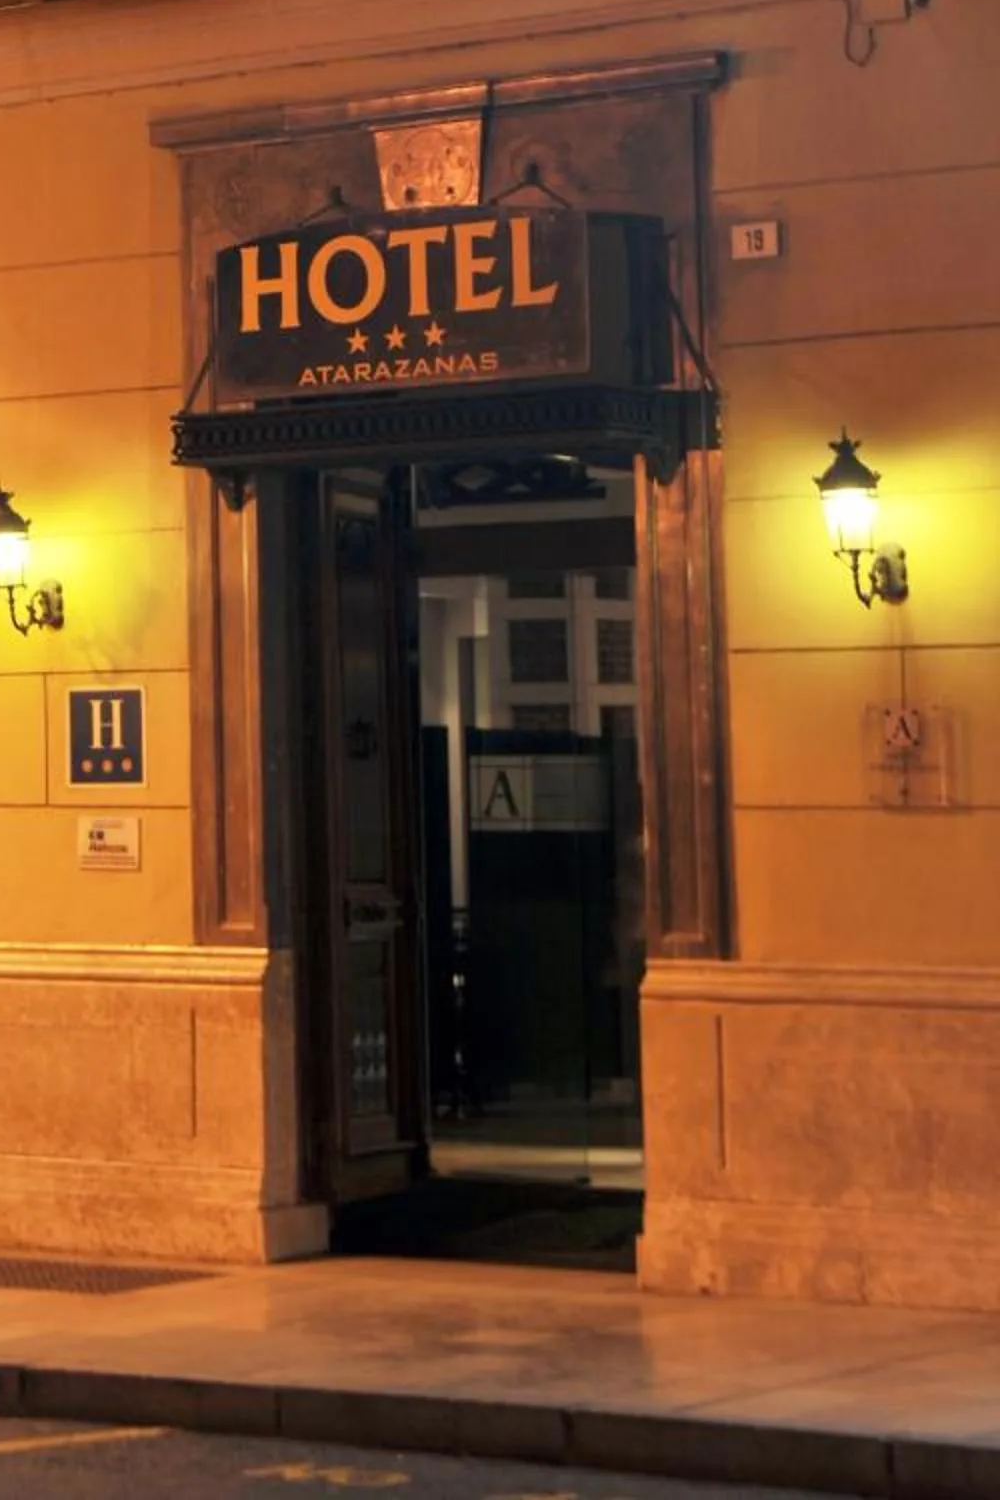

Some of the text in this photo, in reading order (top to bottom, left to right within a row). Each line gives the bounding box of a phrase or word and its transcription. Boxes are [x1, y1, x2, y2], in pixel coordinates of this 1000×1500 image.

[239, 217, 558, 333] HOTEL
[299, 350, 499, 388] ATARAZANAS
[88, 698, 125, 750] H
